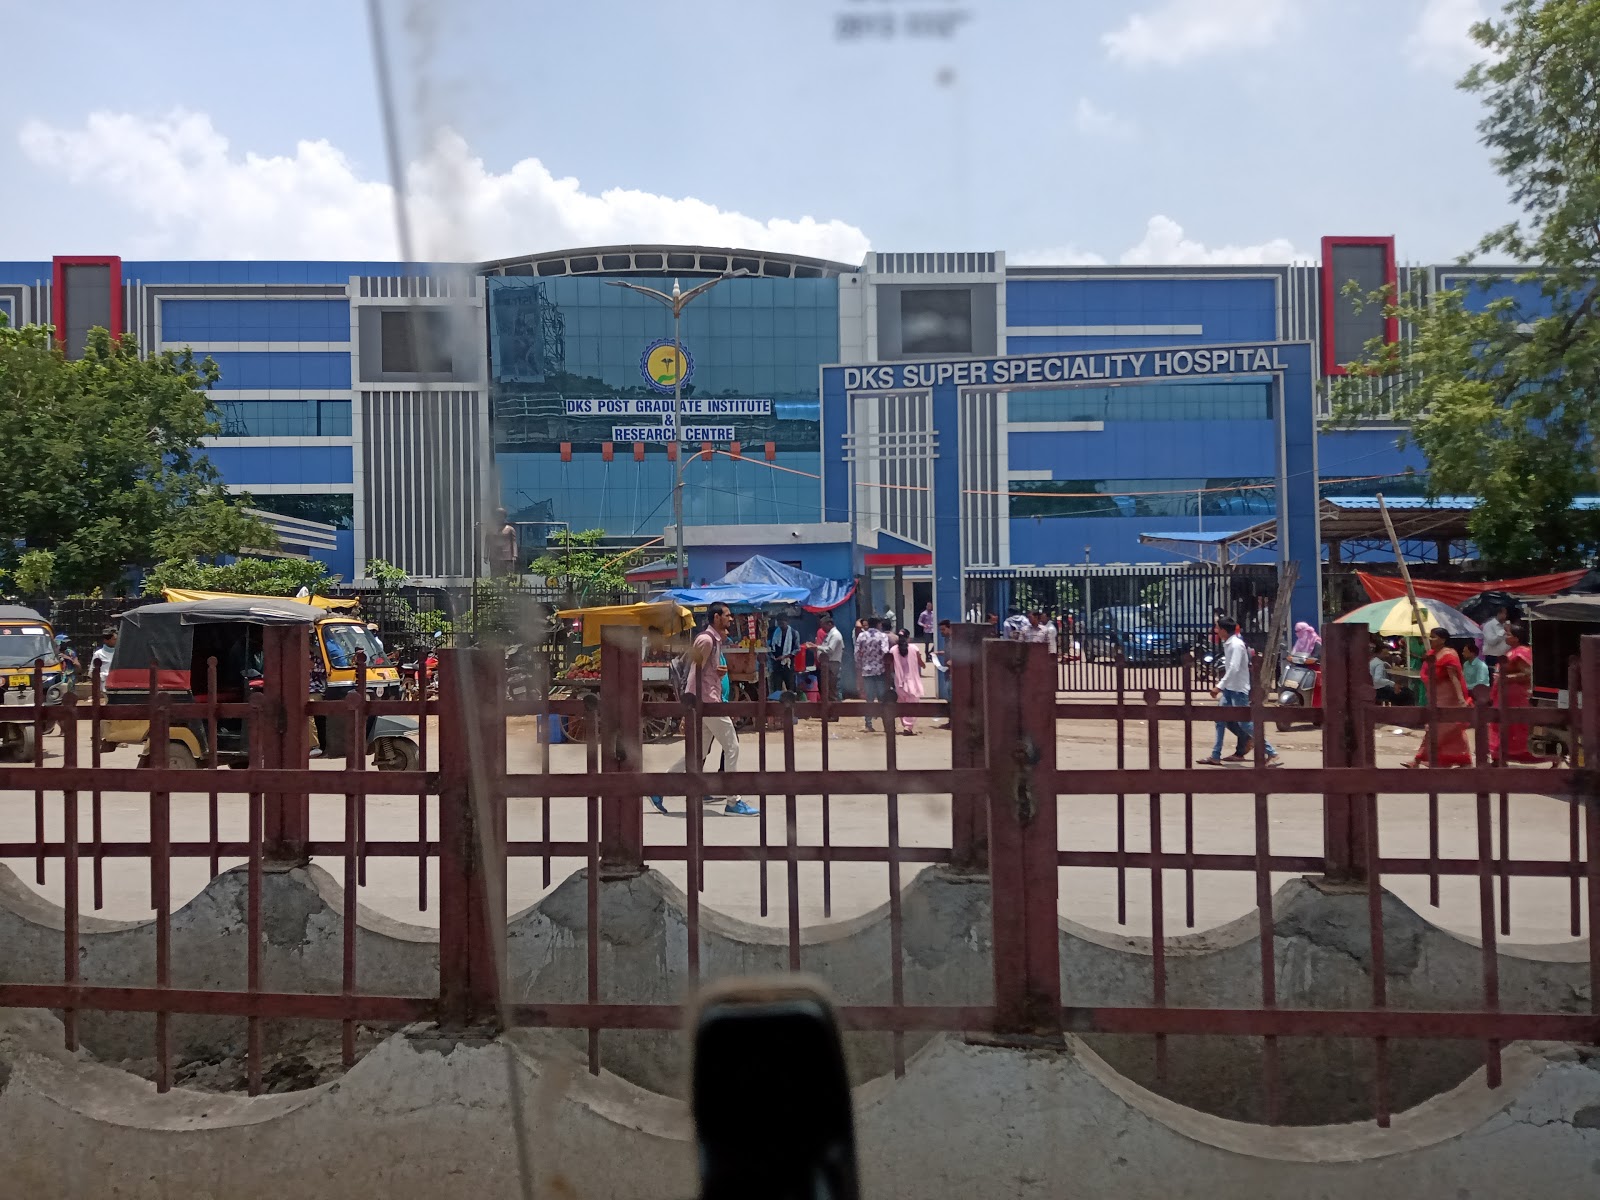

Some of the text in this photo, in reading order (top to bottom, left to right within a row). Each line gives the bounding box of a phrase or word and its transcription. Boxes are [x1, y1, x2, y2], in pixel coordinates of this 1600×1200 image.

[844, 347, 1289, 390] DKS SUPER SPECIALITY HOSPITAL
[567, 400, 770, 413] DKS POST GRADUATE INSTITUTE
[664, 414, 674, 426] &
[686, 428, 733, 441] CENTRE
